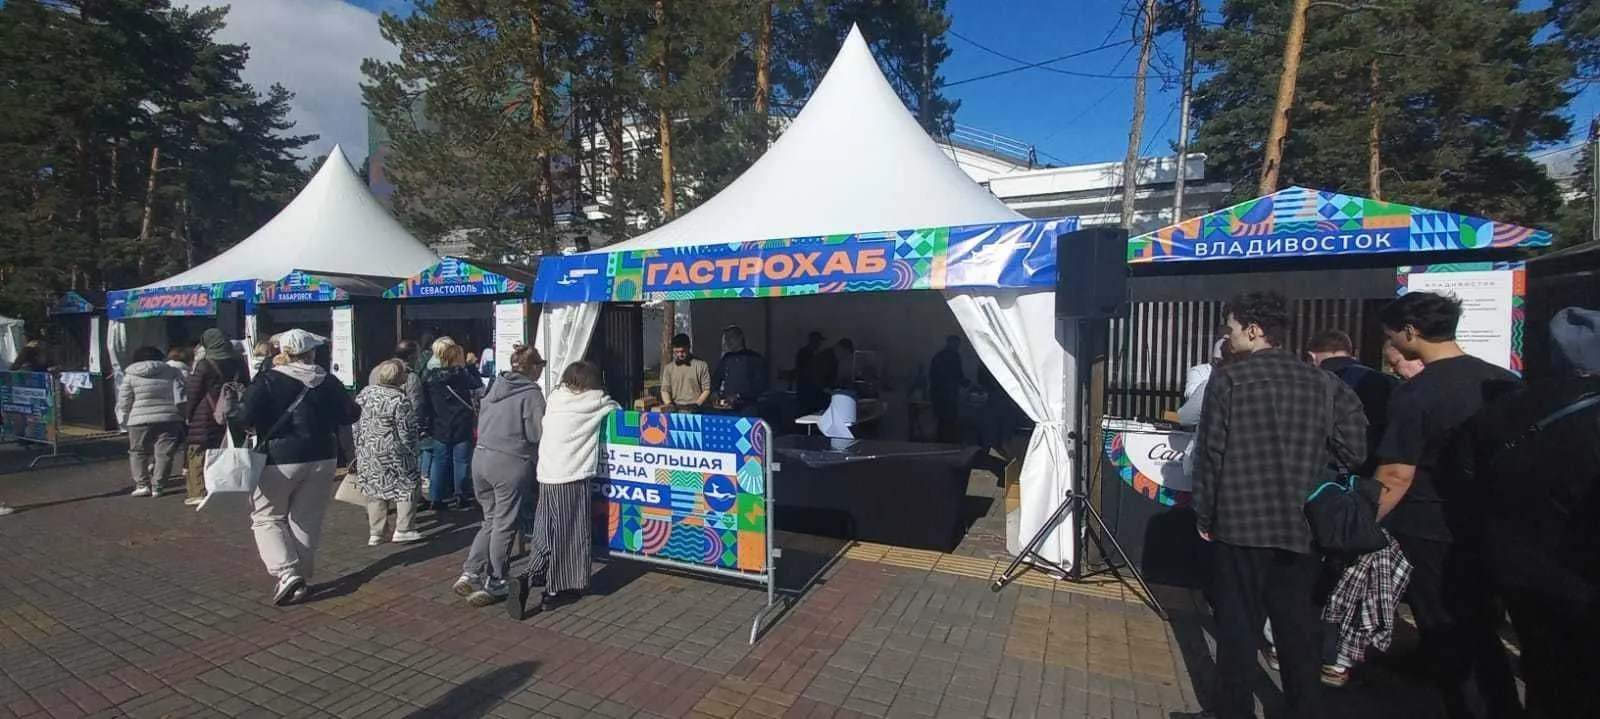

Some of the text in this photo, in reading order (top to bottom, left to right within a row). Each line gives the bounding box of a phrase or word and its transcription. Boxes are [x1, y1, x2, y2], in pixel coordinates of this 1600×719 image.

[1195, 232, 1391, 256] ВЛАДИВОСТОК
[646, 249, 887, 286] ГАСТРОХАБ
[420, 284, 478, 295] СЕВАСТОПОЛЬ
[600, 448, 616, 461] Ы
[633, 451, 723, 470] БОЛЬШАЯ
[1148, 443, 1186, 461] Can
[598, 462, 648, 478] ТРАНА
[590, 482, 661, 504] РОХАБ
